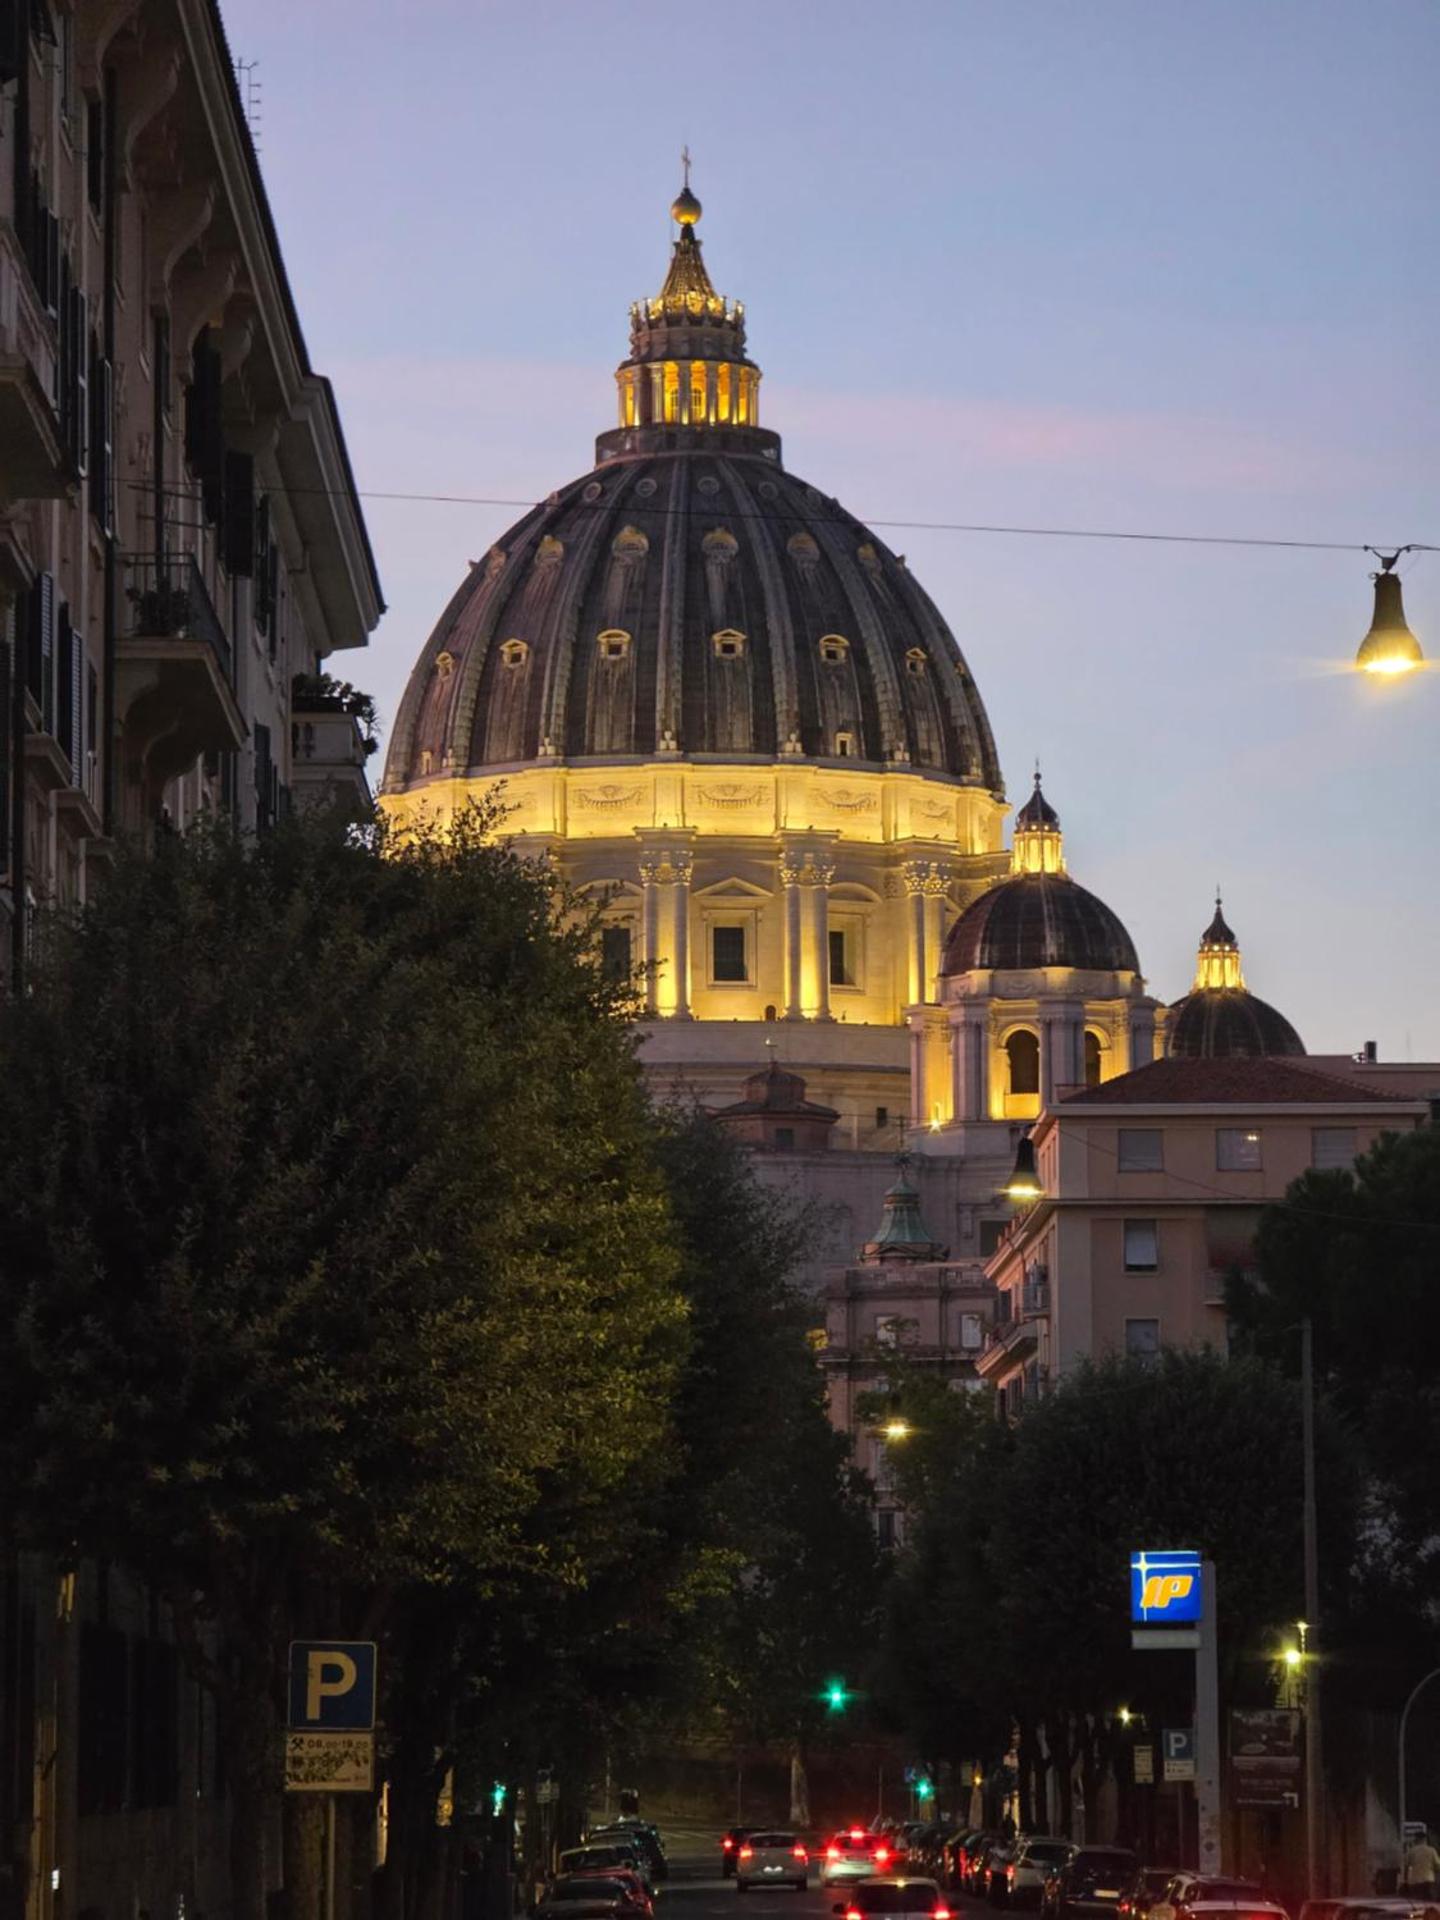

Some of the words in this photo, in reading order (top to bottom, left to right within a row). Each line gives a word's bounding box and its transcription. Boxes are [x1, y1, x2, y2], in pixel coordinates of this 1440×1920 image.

[1140, 1575, 1193, 1608] IP
[306, 1650, 357, 1720] P
[1169, 1731, 1188, 1757] P
